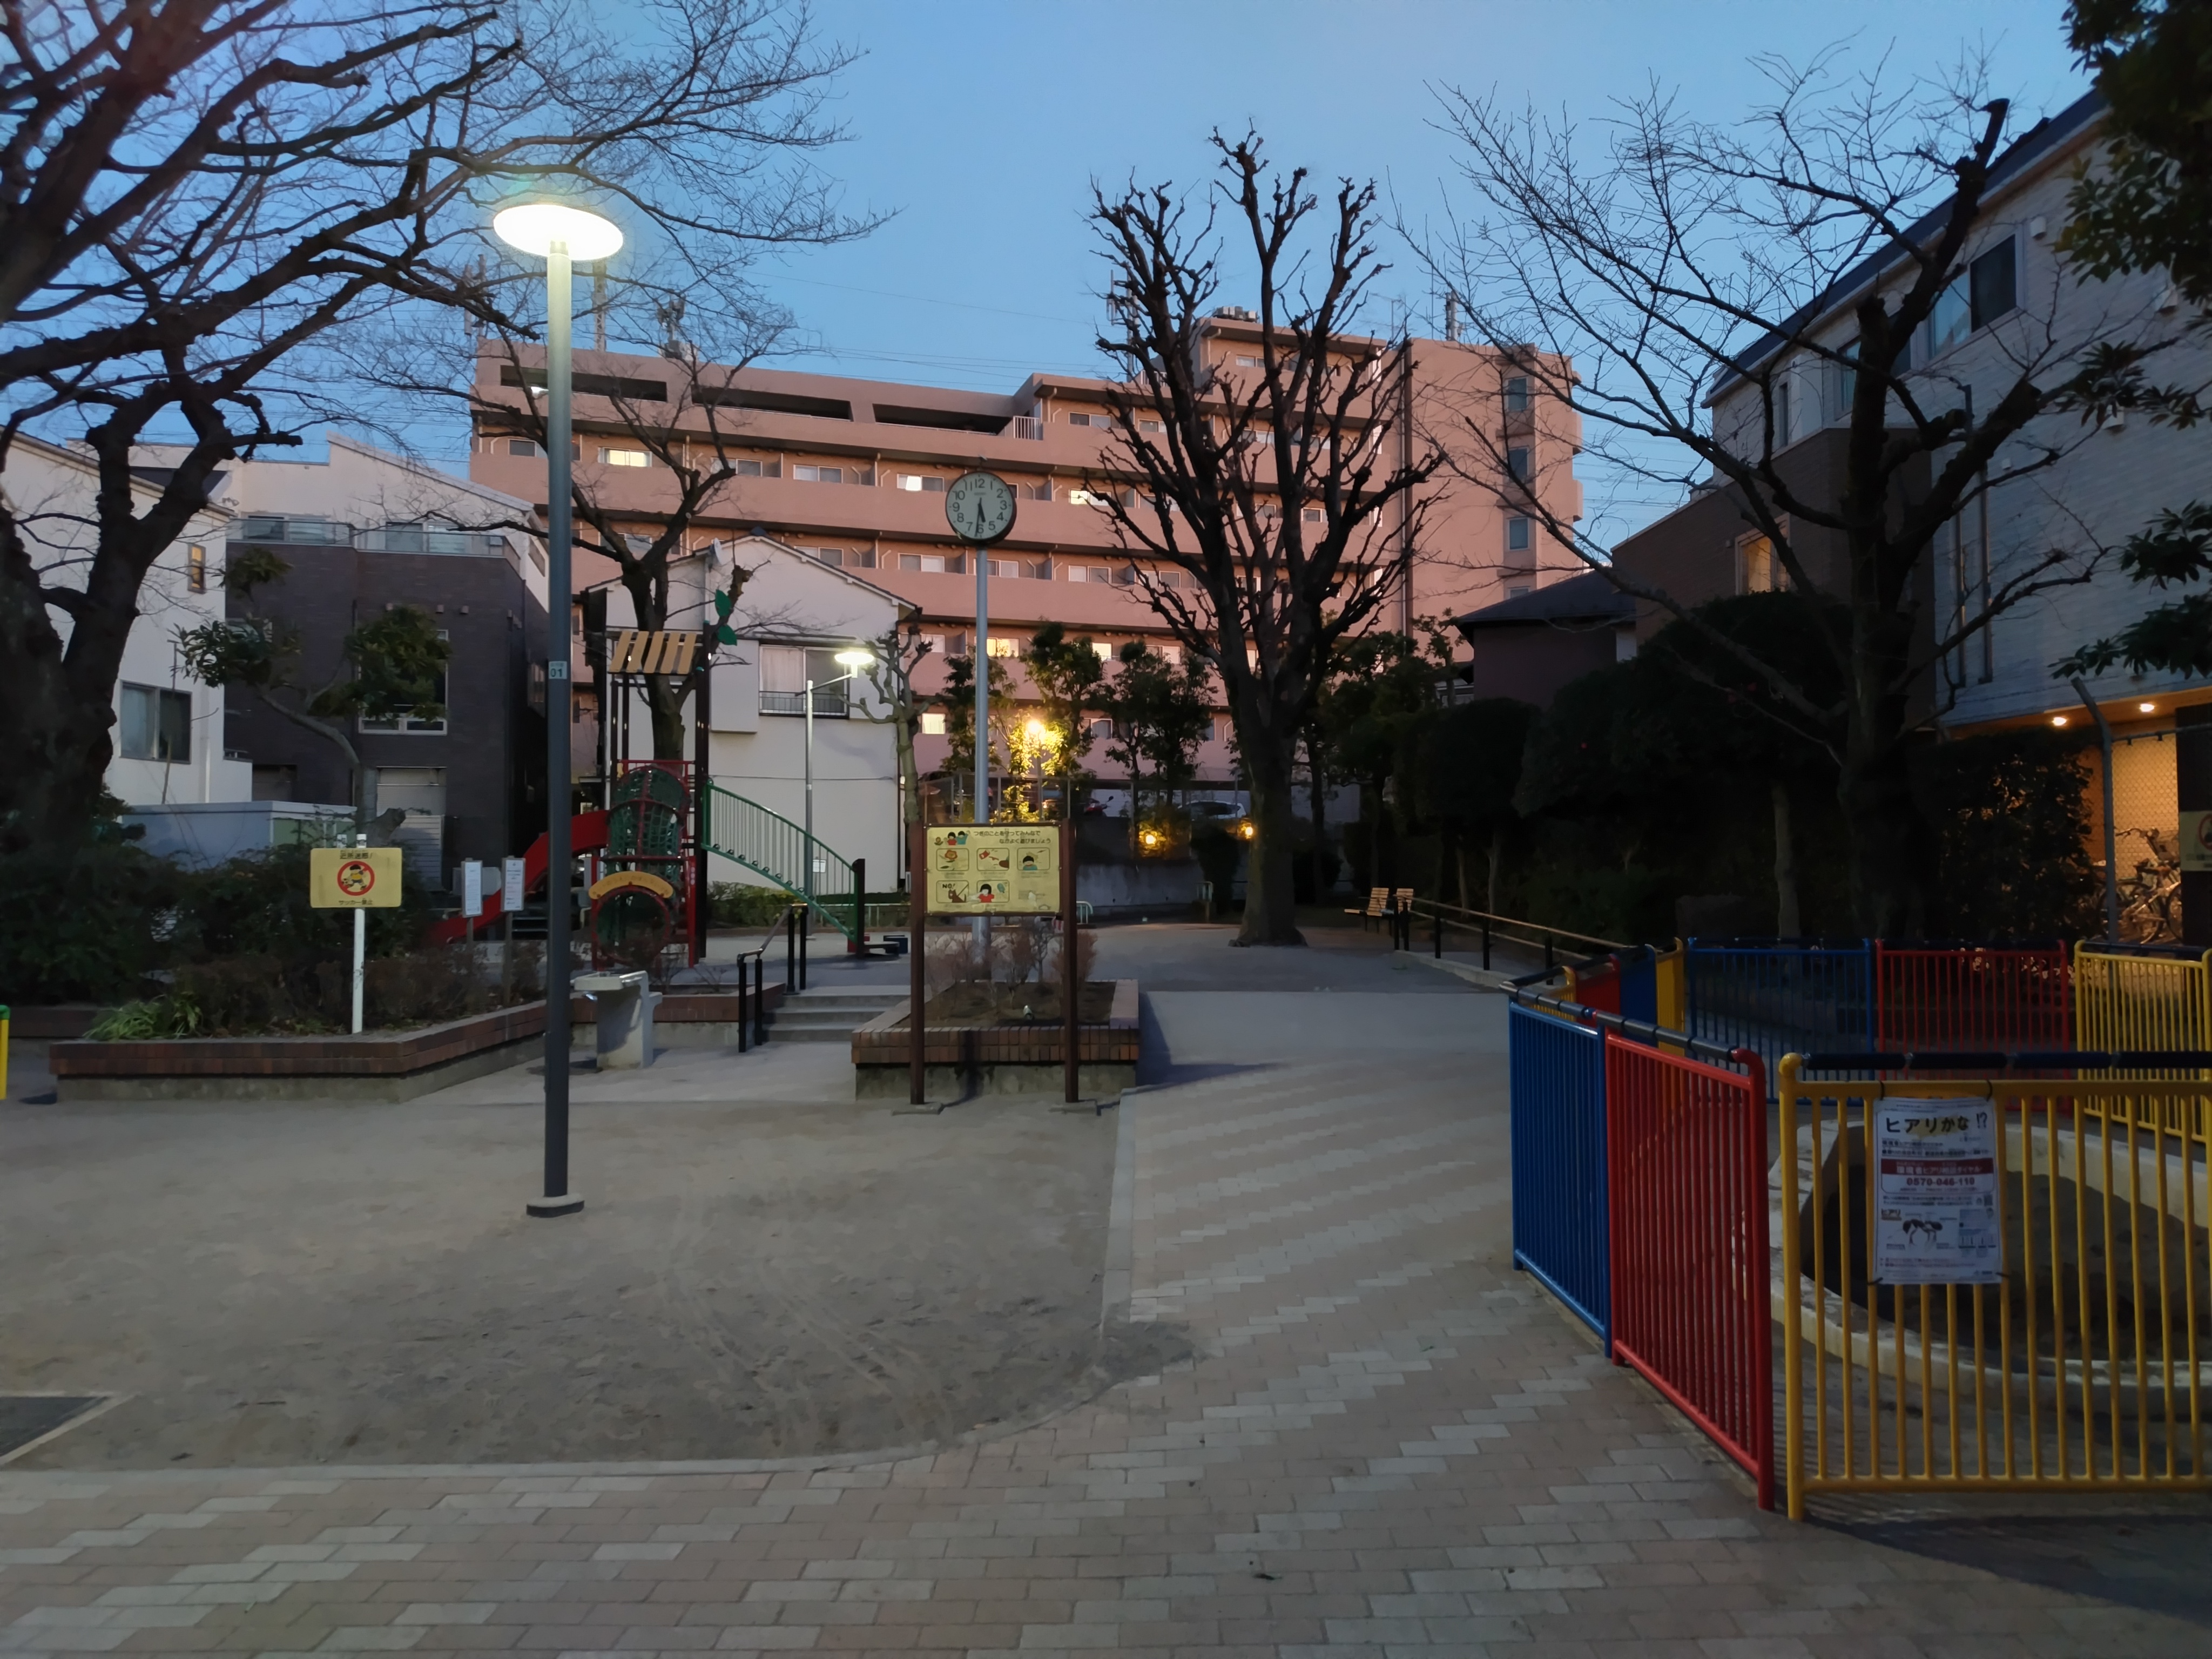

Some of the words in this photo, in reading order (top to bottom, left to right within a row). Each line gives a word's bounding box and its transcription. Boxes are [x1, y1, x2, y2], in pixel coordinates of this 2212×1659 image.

[965, 480, 972, 491] 11
[975, 478, 985, 488] 12
[954, 490, 965, 500] 10
[996, 489, 1003, 498] 2
[952, 502, 960, 512] 9
[1000, 500, 1007, 510] 3
[957, 512, 965, 523] 8
[996, 512, 1004, 521] 4
[966, 522, 973, 531] 7
[976, 524, 984, 534] 6
[988, 521, 996, 530] 5
[550, 668, 562, 677] 01
[1907, 1177, 1975, 1186] 0570-046-110
